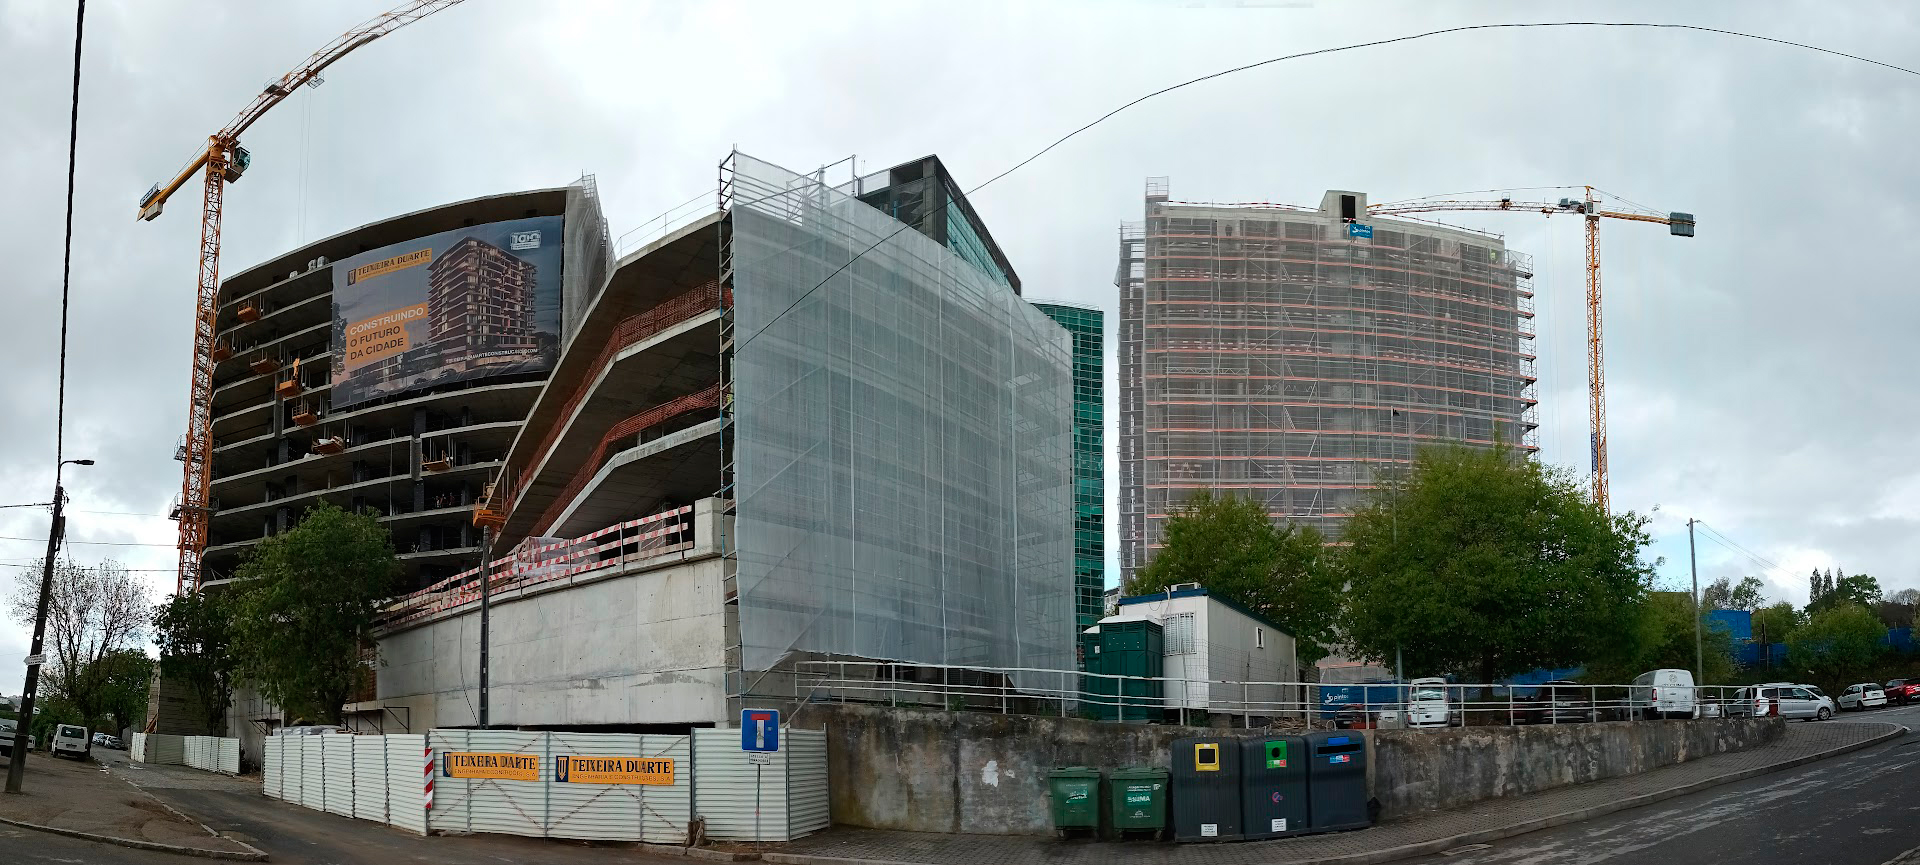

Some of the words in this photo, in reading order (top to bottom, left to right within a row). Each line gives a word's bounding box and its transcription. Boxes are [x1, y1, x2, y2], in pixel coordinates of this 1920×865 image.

[358, 259, 395, 275] TEIXEIRA
[397, 249, 430, 264] DUARTE
[350, 307, 424, 335] CONSTRUINDO
[350, 339, 357, 347] O
[360, 325, 401, 345] FUTURO
[350, 349, 364, 360] DA
[365, 337, 404, 355] CIDADE
[572, 759, 622, 772] TEIXEIRA
[626, 760, 671, 774] DUARTE
